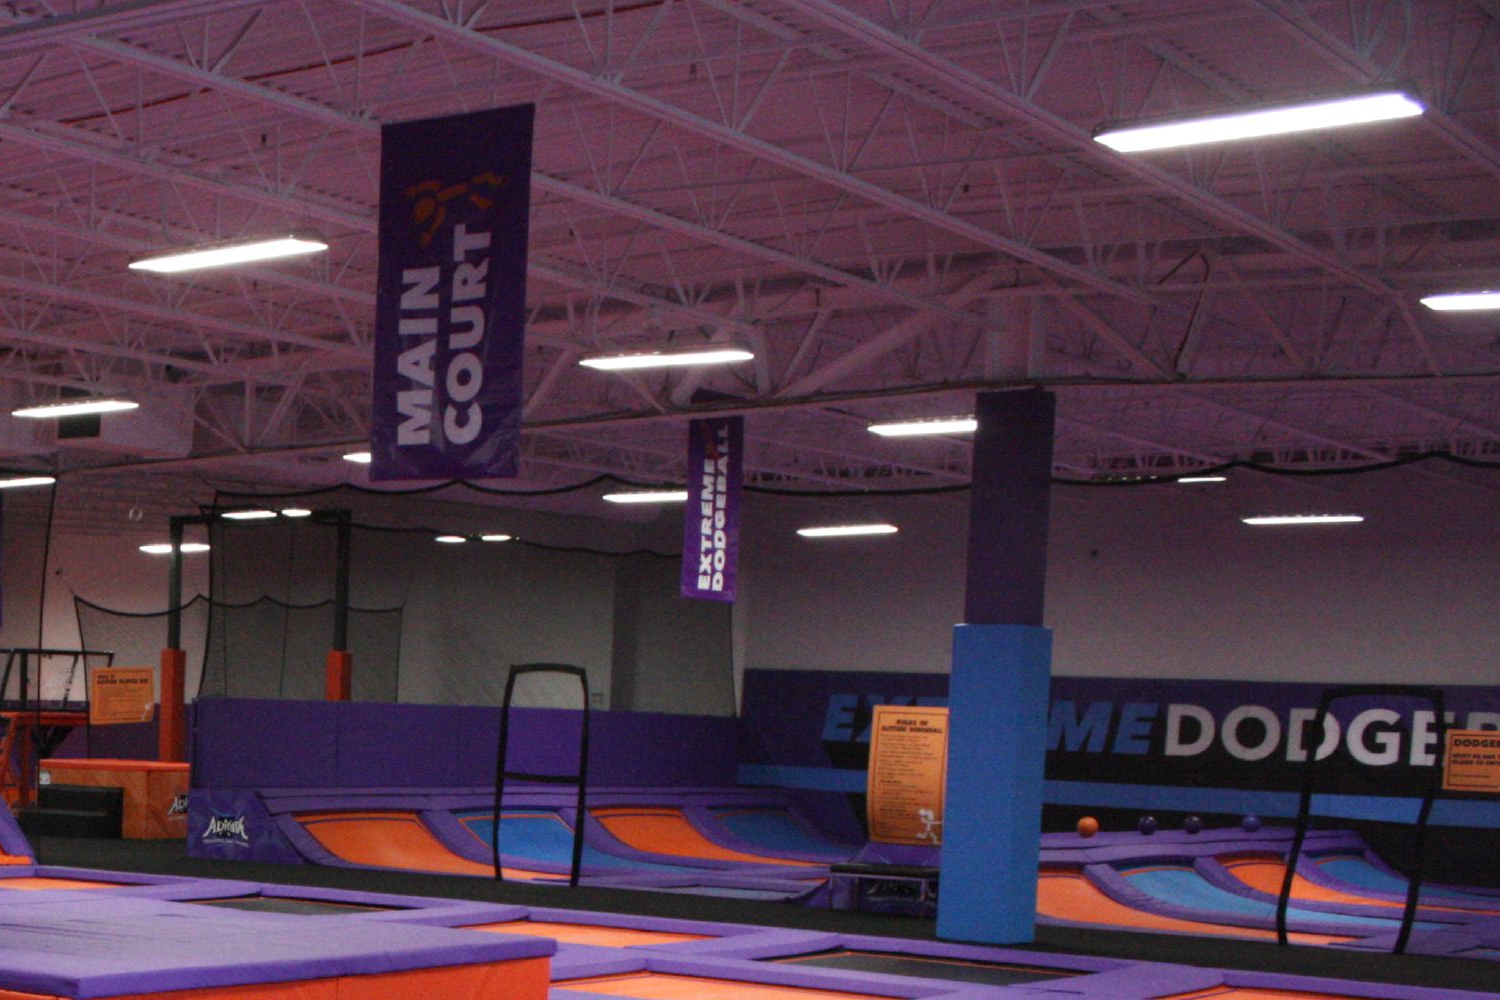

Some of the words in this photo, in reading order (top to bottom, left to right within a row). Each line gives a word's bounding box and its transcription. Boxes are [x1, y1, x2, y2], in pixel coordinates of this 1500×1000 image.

[397, 266, 440, 446] MAIN
[444, 223, 492, 445] COURT
[697, 457, 716, 590] EXTREME
[712, 425, 729, 592] DODGEBALL
[1164, 703, 1500, 766] DODGE
